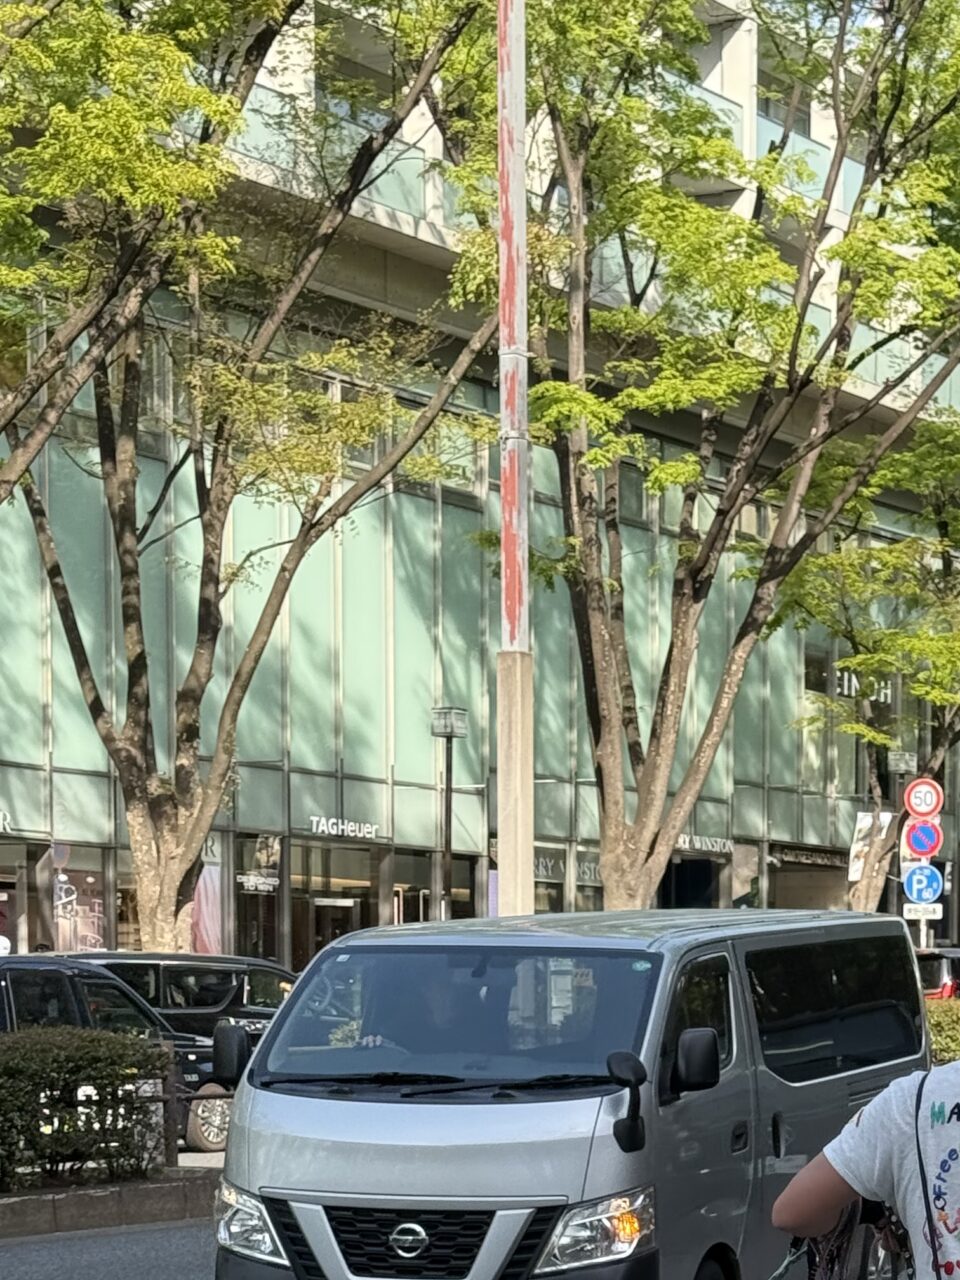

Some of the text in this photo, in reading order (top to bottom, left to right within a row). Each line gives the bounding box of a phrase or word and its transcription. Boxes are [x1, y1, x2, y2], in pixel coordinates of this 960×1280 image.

[913, 790, 934, 807] 50
[692, 835, 735, 854] WINSTON
[911, 874, 928, 899] P
[933, 1148, 959, 1197] Free
